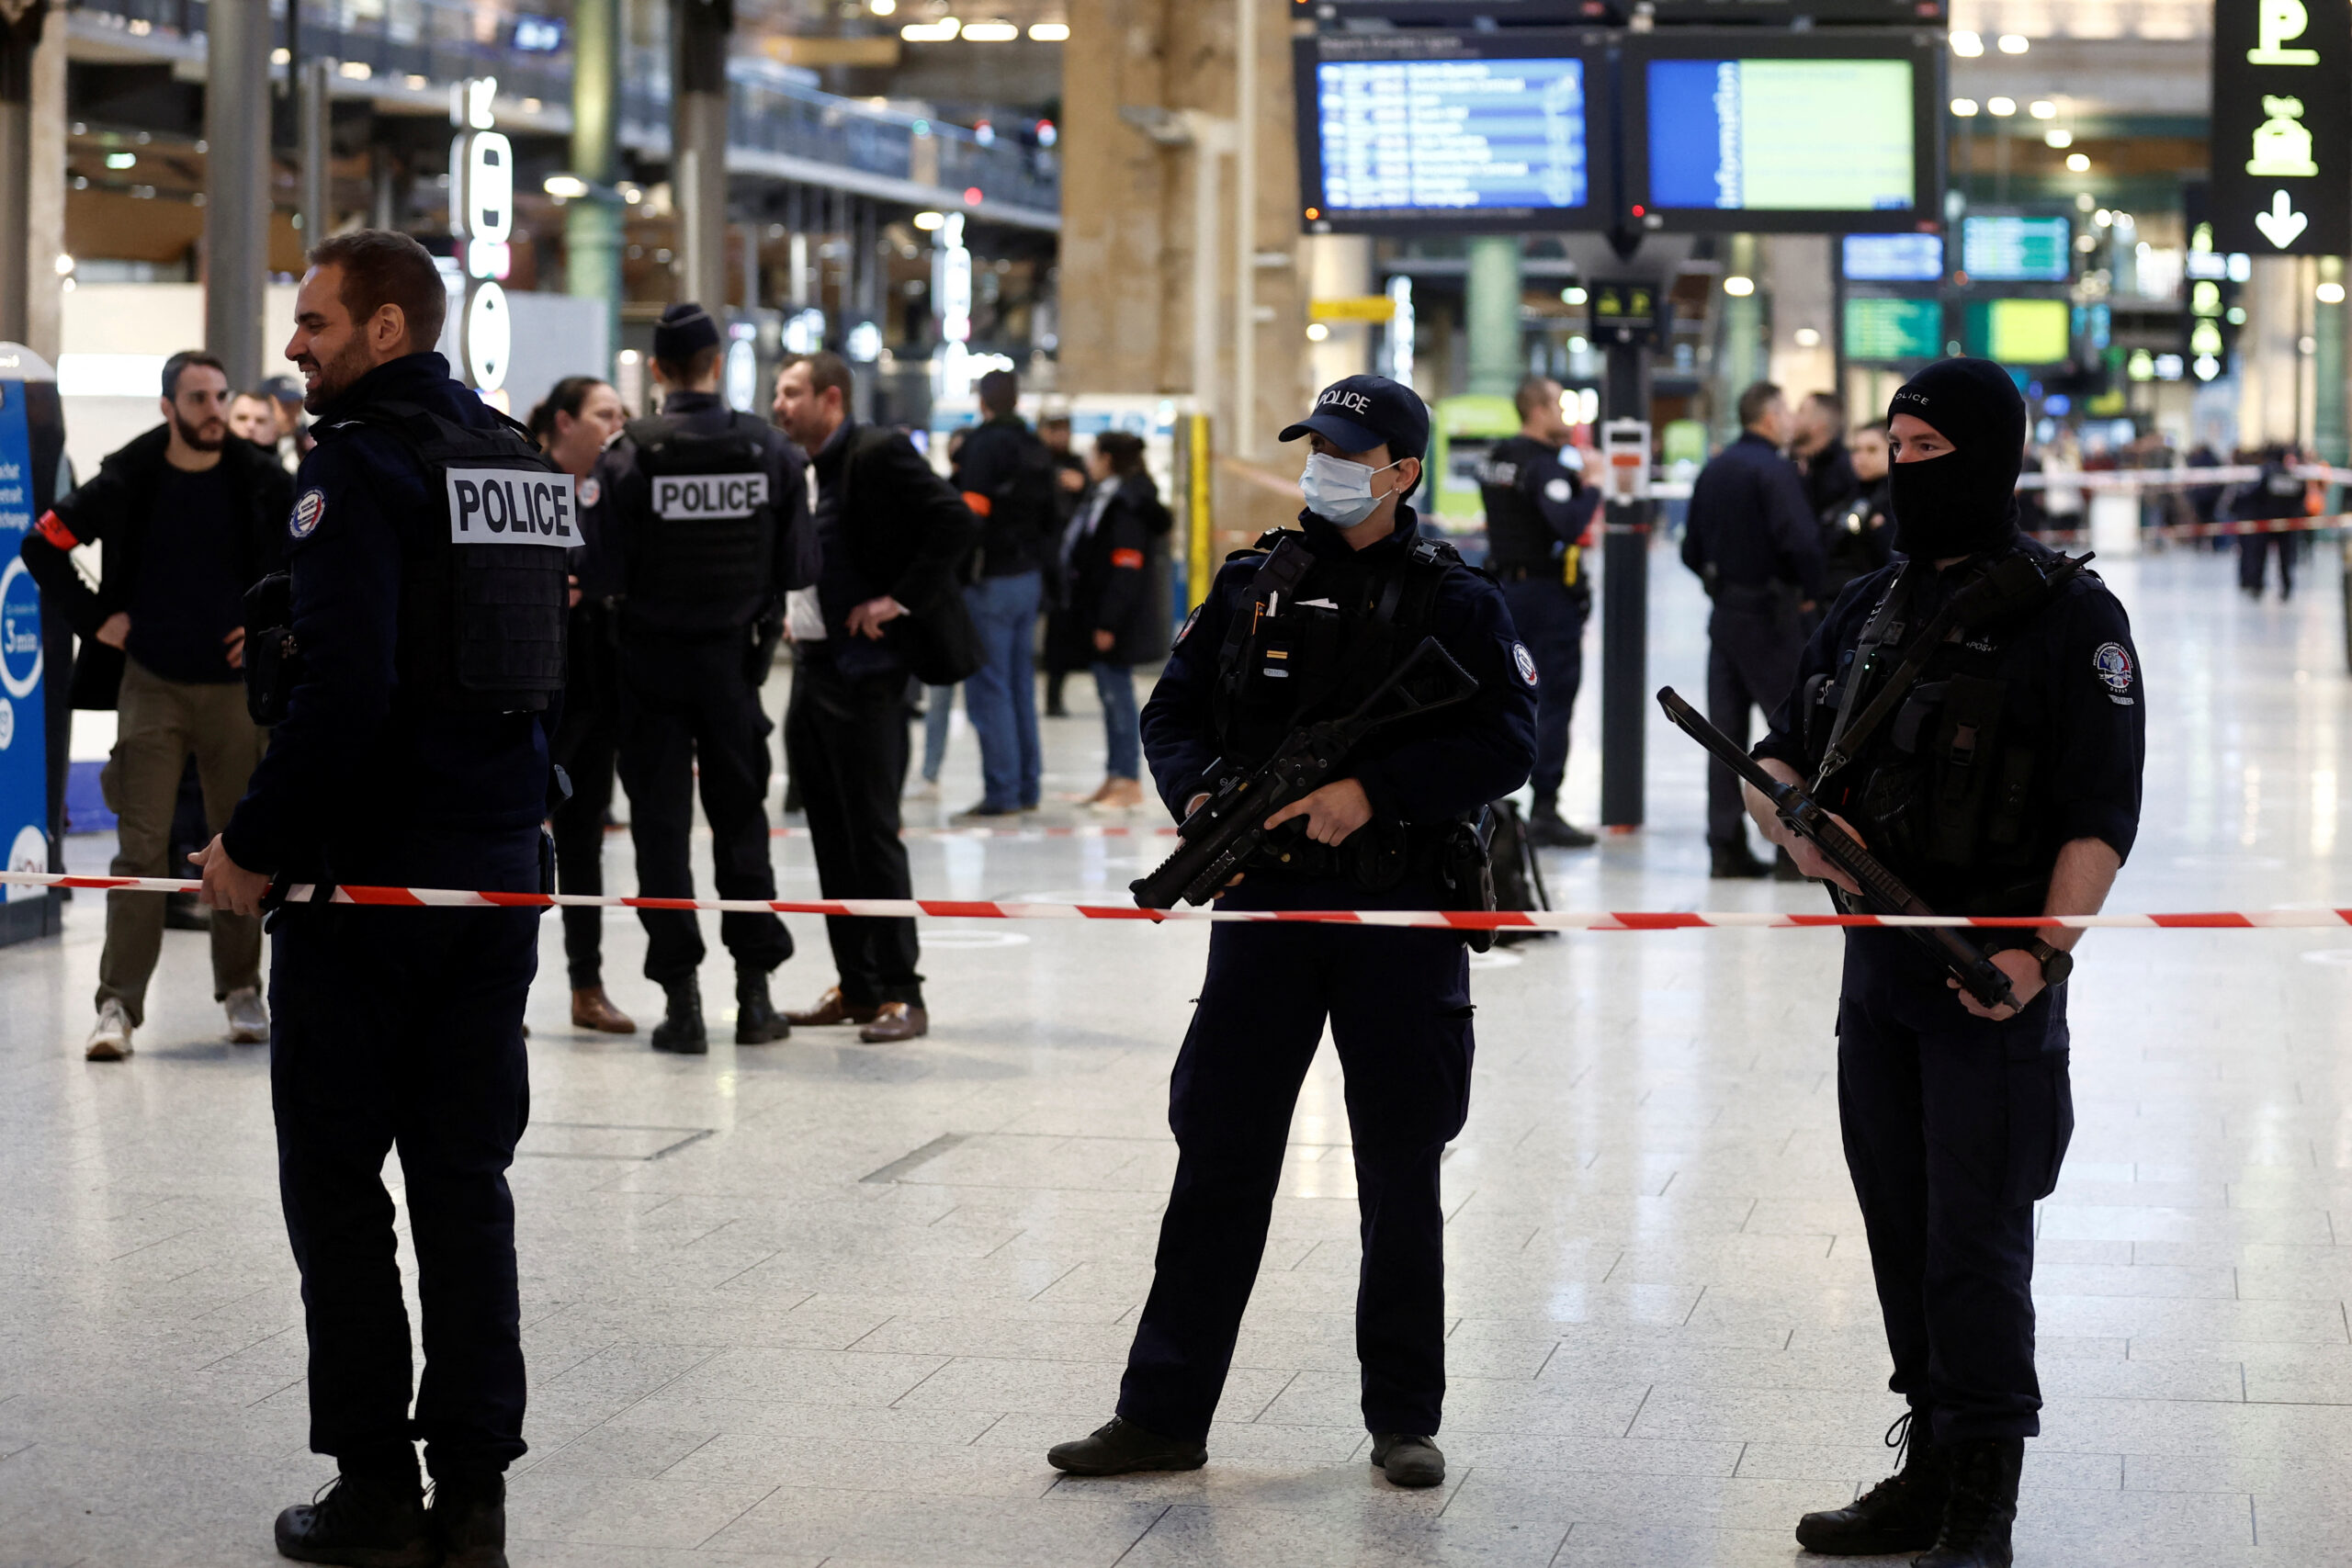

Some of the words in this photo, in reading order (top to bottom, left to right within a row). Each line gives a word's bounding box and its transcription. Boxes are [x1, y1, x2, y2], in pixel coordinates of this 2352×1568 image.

[1315, 390, 1371, 415] POLICE
[1894, 392, 1929, 405] OLICE
[454, 479, 571, 537] POLICE
[662, 480, 761, 512] POLICE
